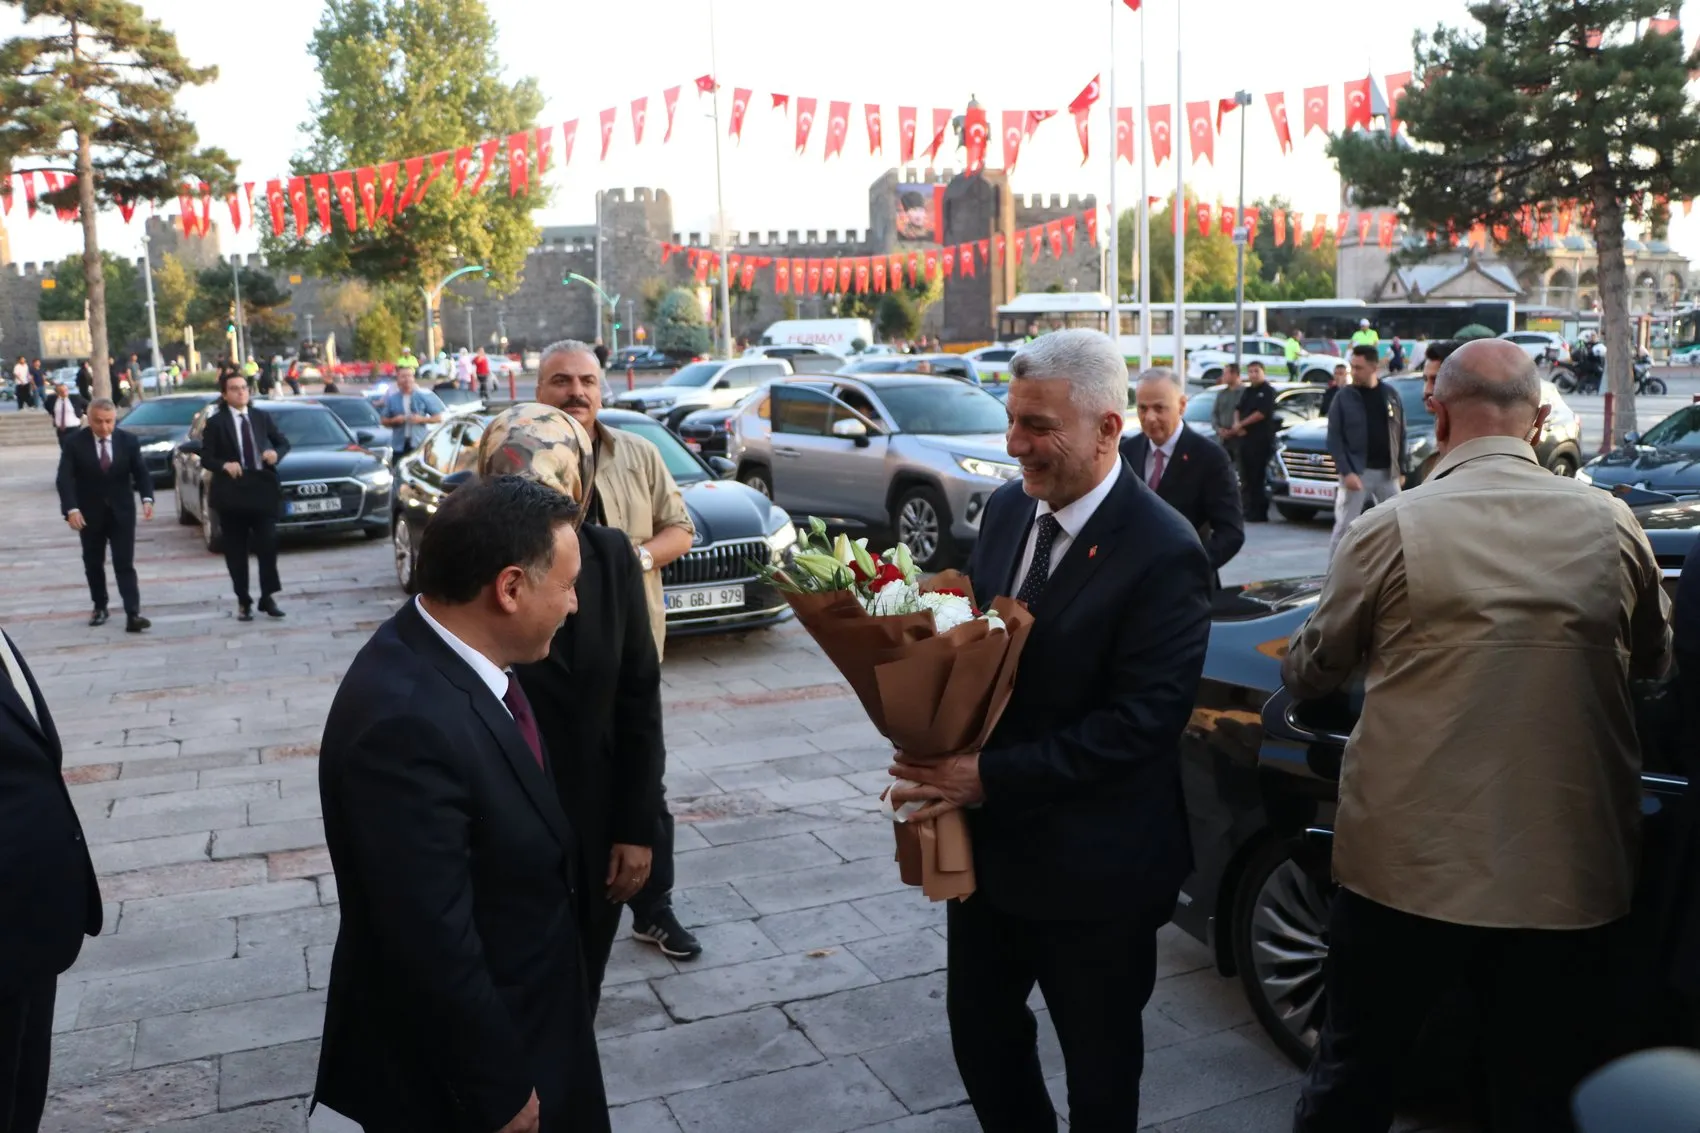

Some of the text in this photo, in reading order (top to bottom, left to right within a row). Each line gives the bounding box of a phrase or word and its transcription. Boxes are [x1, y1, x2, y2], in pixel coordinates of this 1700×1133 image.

[668, 589, 742, 609] 06 GBJ 979
